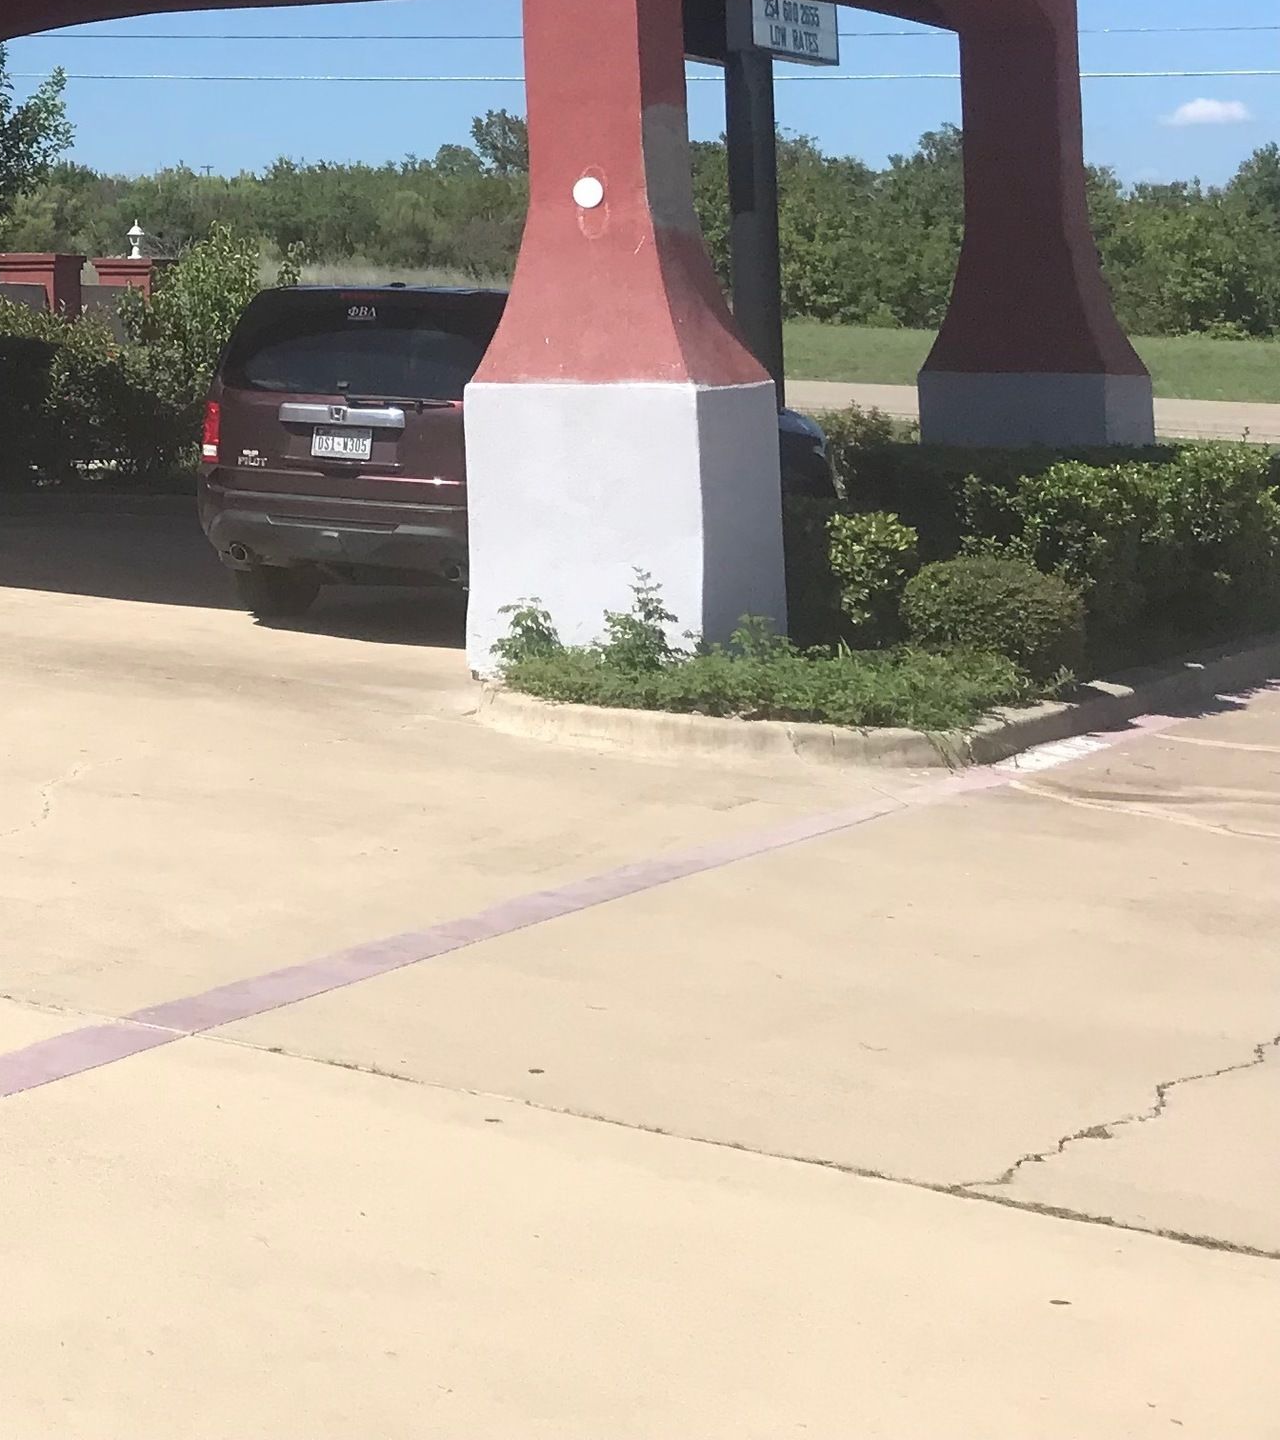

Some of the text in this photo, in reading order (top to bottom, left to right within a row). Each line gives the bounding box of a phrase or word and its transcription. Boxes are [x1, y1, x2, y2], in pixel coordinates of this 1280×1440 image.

[769, 24, 819, 53] LOW RATES
[237, 455, 268, 467] PILOT
